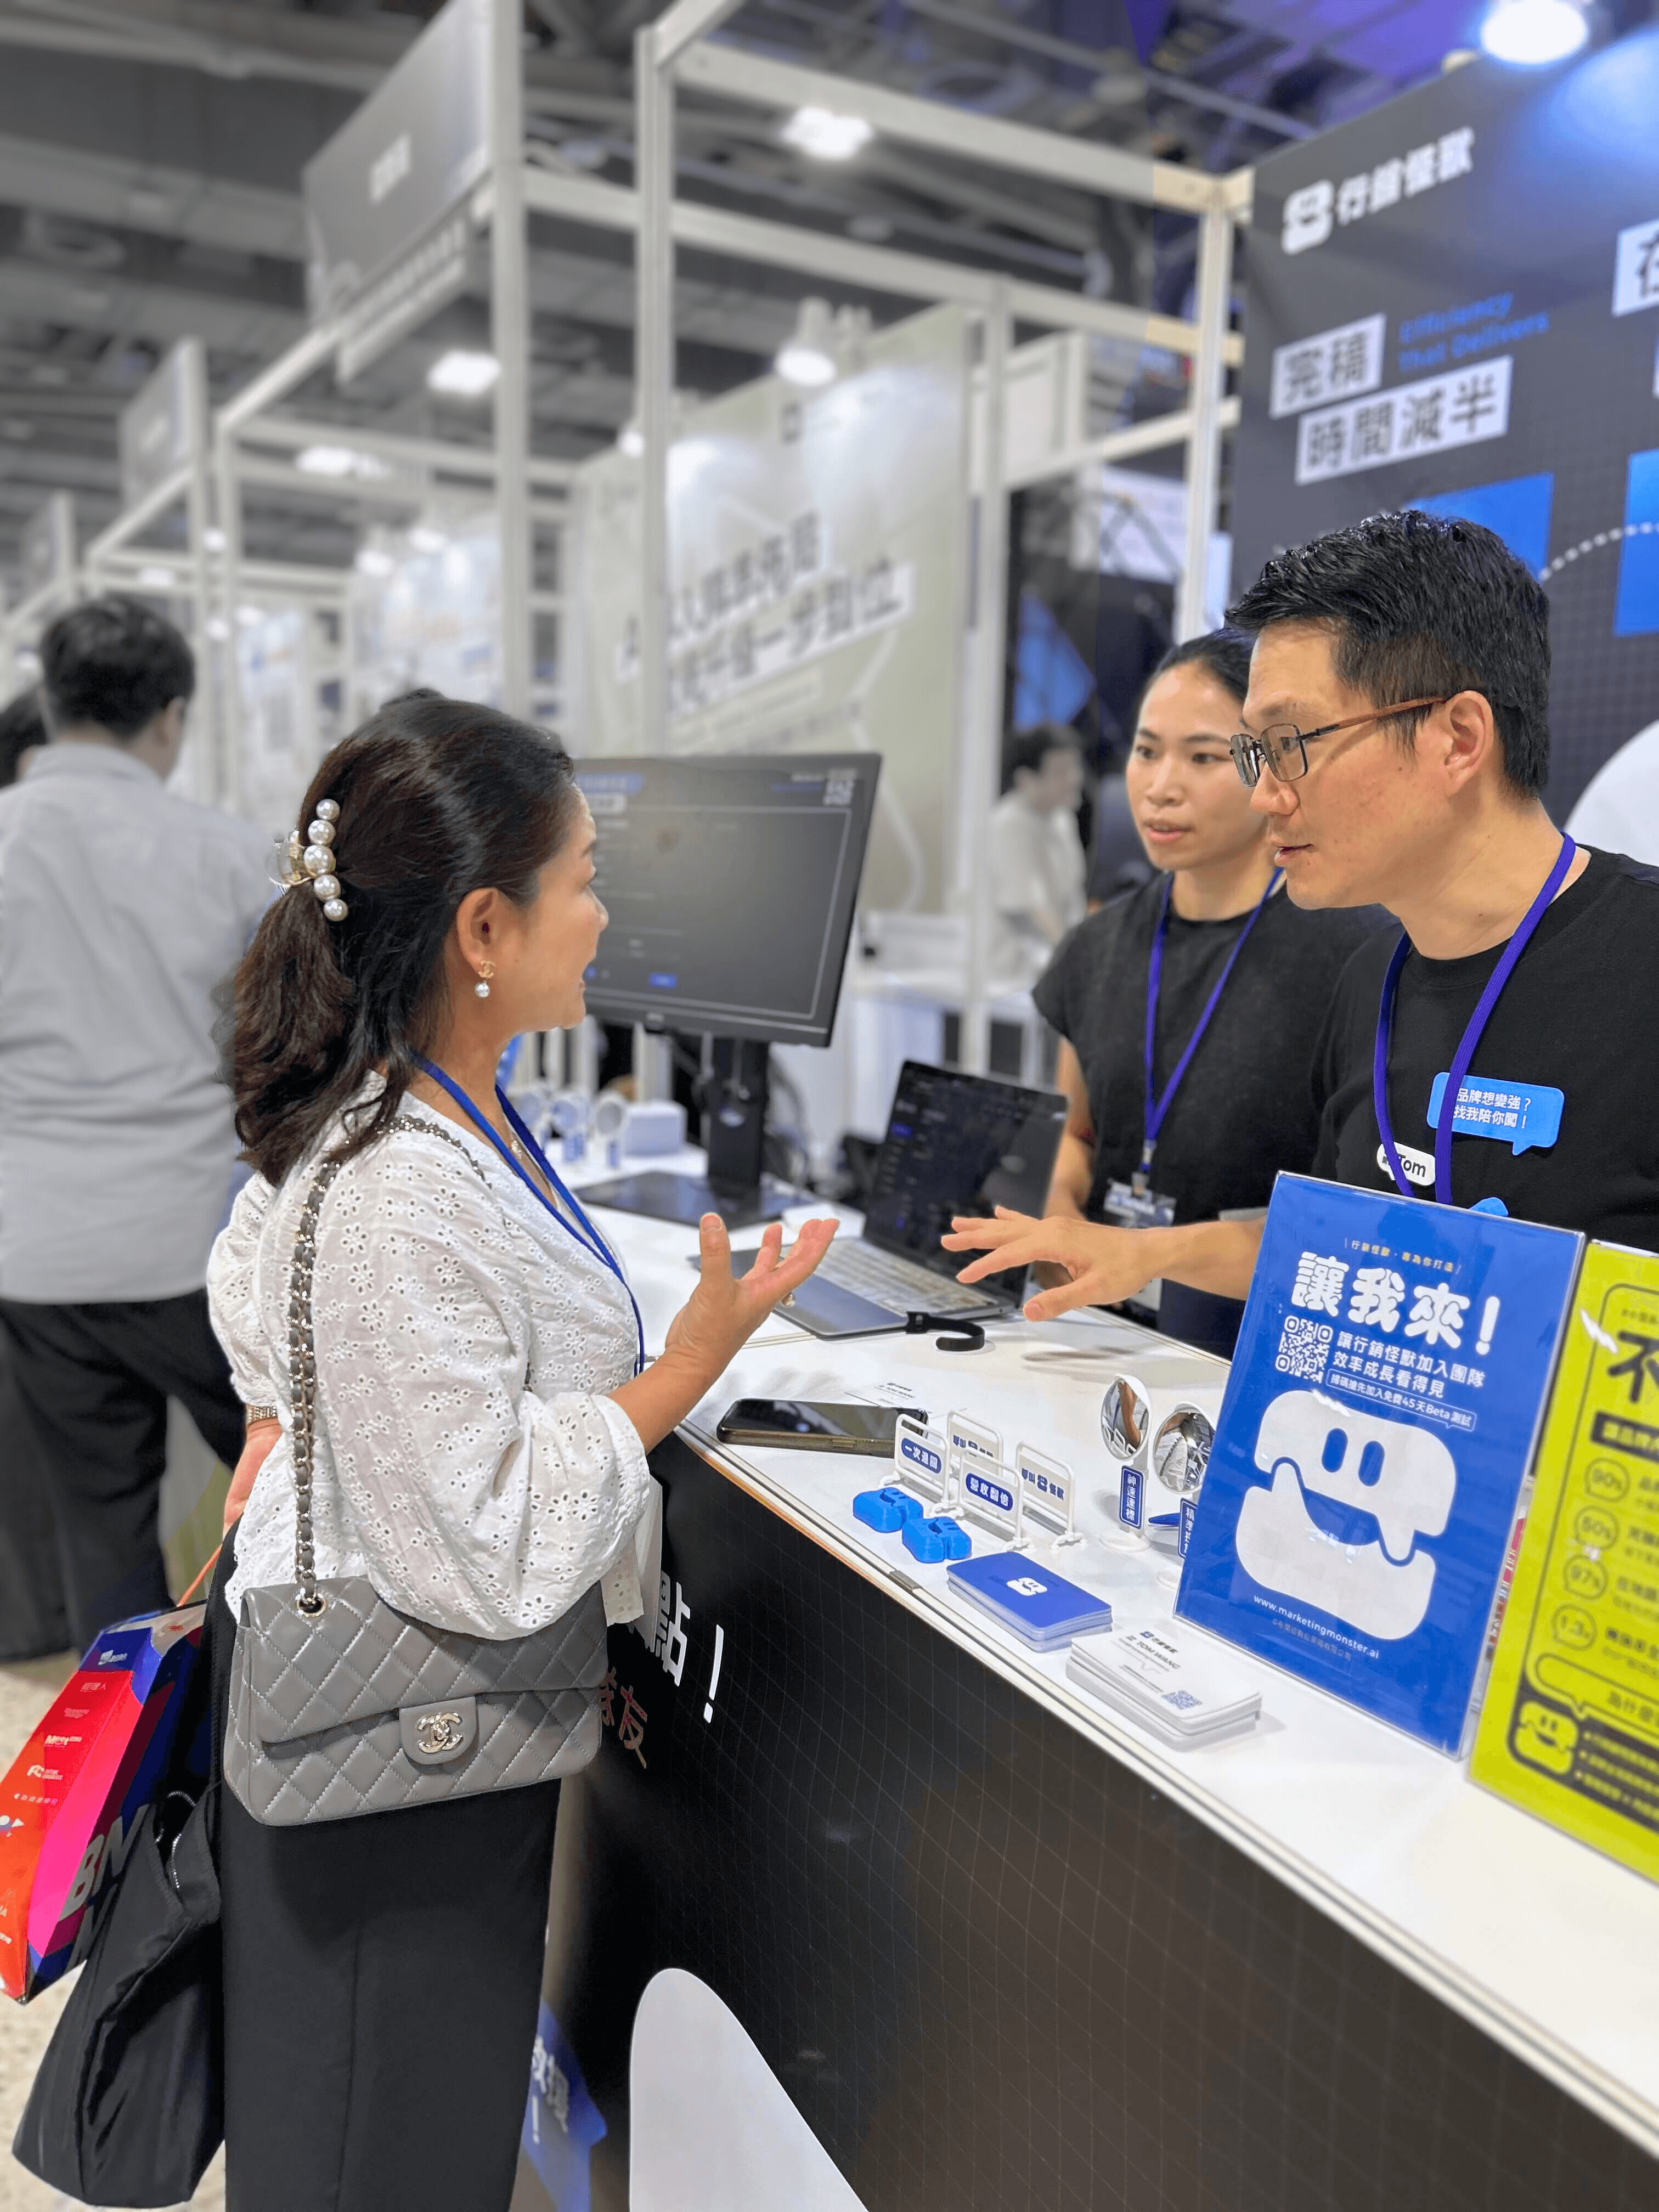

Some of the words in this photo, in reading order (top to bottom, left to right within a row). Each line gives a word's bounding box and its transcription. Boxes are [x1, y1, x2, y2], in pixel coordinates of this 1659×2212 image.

[1307, 375, 1496, 469] 時間減半
[1453, 1104, 1527, 1129] 找我陪你闖！
[1457, 1088, 1531, 1111] 品牌想變強？
[1291, 1250, 1500, 1355] 讓我來！
[1333, 1352, 1444, 1398] 效率成長看得見
[1337, 1330, 1486, 1387] 讓行銷怪獸加入團隊
[1254, 1595, 1379, 1658] www.marketingmonster.ai
